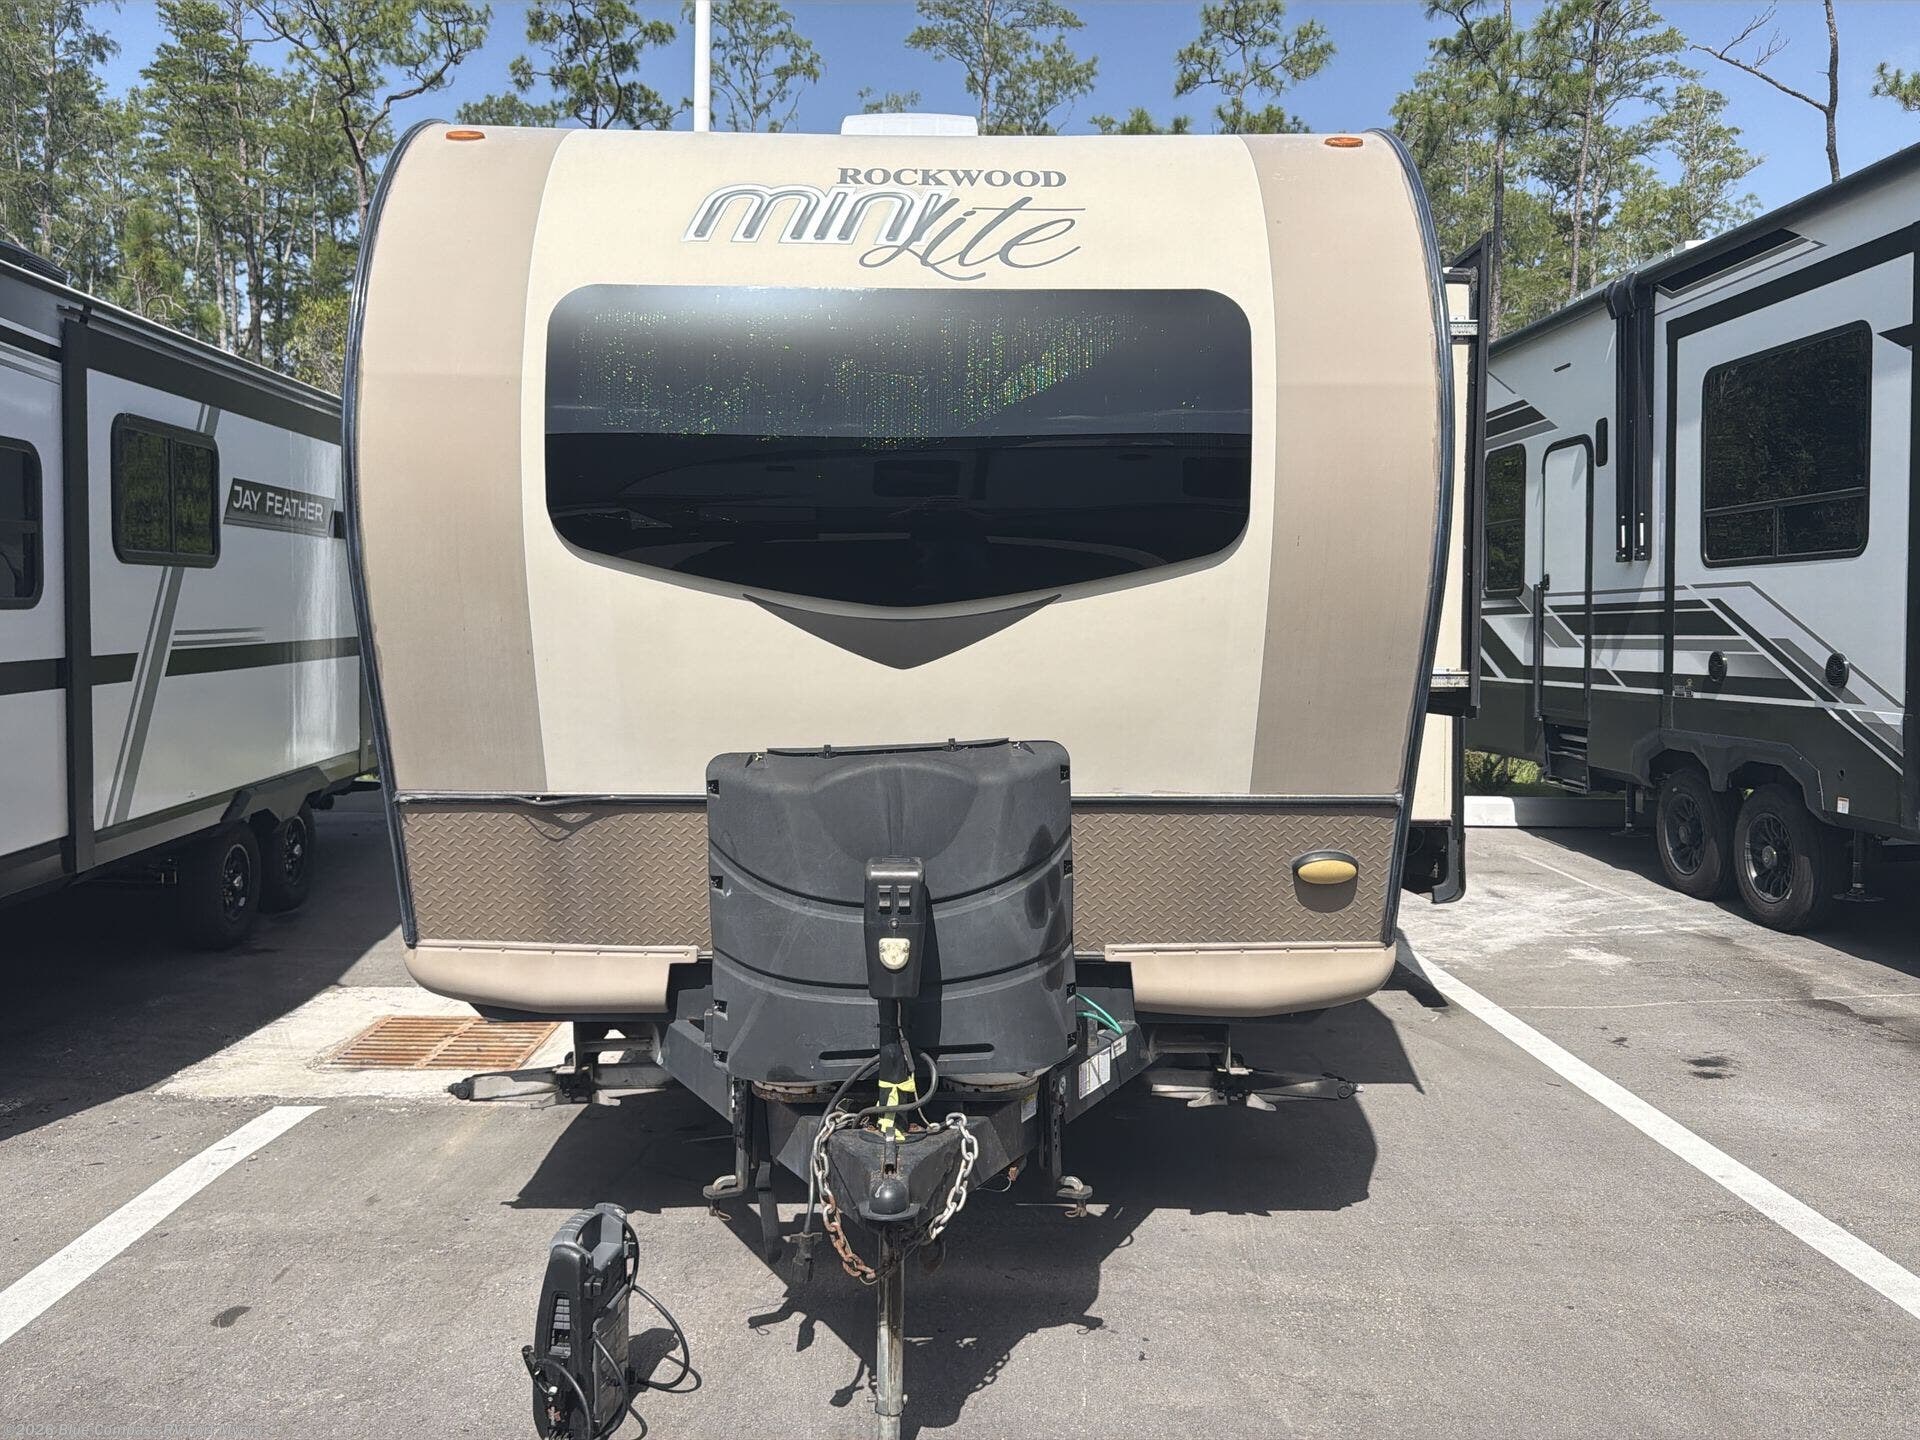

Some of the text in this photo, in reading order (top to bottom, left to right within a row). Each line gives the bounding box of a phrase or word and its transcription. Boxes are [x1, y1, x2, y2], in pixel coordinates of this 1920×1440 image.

[836, 167, 1067, 188] ROCKWOOD
[859, 196, 1086, 282] Lite
[232, 485, 324, 522] JAY FEATHER
